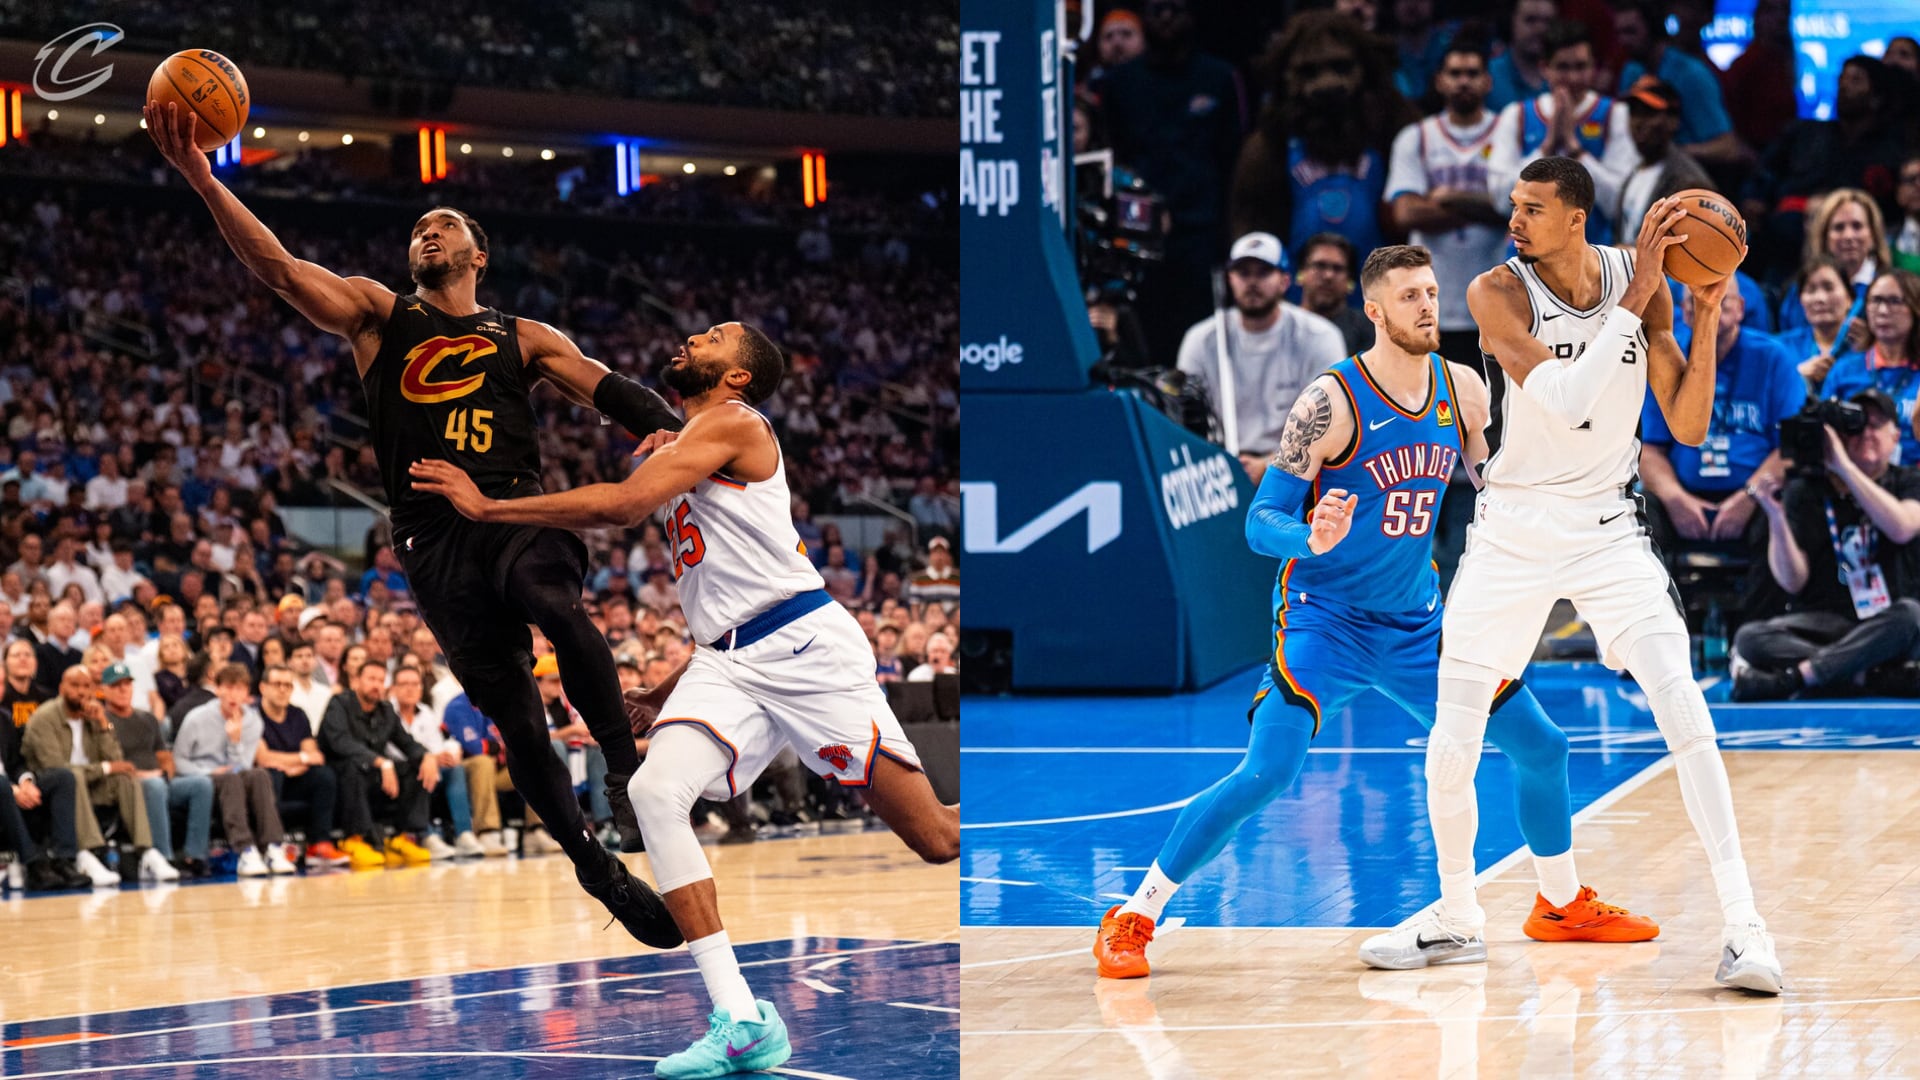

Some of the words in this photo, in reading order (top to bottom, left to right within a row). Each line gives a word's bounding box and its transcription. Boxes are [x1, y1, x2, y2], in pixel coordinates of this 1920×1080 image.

[960, 31, 1002, 85] ET
[960, 149, 1020, 217] App
[476, 324, 508, 337] CLIFFS
[400, 334, 498, 404] C
[444, 407, 494, 454] 45
[1161, 443, 1239, 530] coinbase
[1382, 490, 1437, 538] 55
